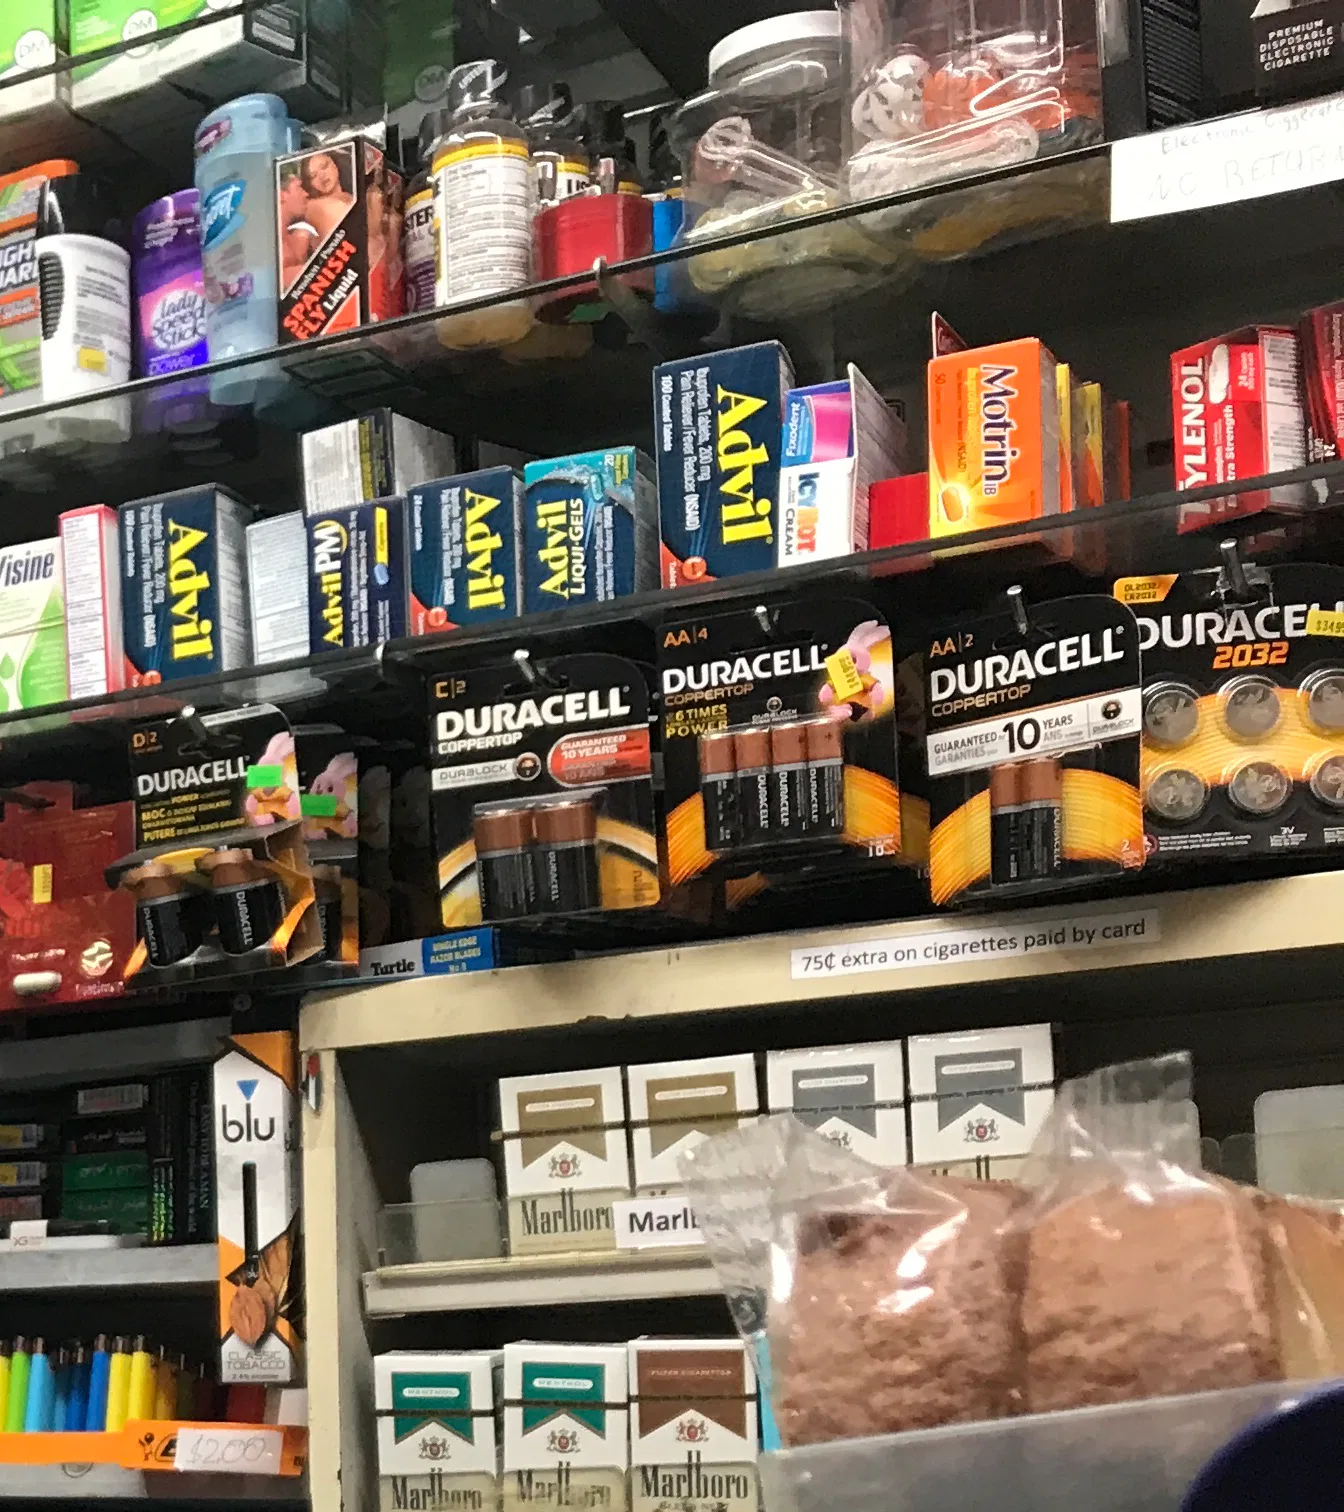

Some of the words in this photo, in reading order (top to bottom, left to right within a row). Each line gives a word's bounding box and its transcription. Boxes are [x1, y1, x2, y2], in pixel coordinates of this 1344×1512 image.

[1259, 27, 1333, 53] DISPOSABLE
[1261, 36, 1335, 62] ELECTRONIC
[1268, 19, 1324, 42] PREMIUM
[786, 402, 800, 457] Fixodent
[980, 364, 1020, 486] Motrin
[716, 384, 773, 545] Advil
[465, 488, 506, 611] Advil
[784, 508, 795, 556] CREAM
[168, 518, 214, 661] Advil
[663, 645, 827, 694] DURACELL
[930, 626, 1125, 702] DURACELL
[1212, 641, 1290, 669] 2032
[436, 686, 632, 740] DURACELL
[664, 682, 754, 706] COPPERTOP
[931, 684, 1031, 717] COPPERTOP
[437, 731, 523, 754] COPPERTOP
[933, 732, 998, 755] GUARANTEED
[1003, 717, 1041, 756] 10
[1042, 715, 1074, 730] YEARS
[137, 756, 249, 797] DURACELL
[802, 951, 837, 973] 75¢
[841, 949, 888, 969] extra
[894, 949, 917, 962] on
[923, 936, 1017, 961] cigarettes
[1024, 928, 1066, 952] paid
[1072, 925, 1096, 945] by
[1102, 918, 1146, 939] card
[370, 959, 416, 977] Turtle
[221, 1102, 276, 1145] blu
[392, 1468, 483, 1511] Marlboro
[640, 1450, 748, 1500] Marlboro
